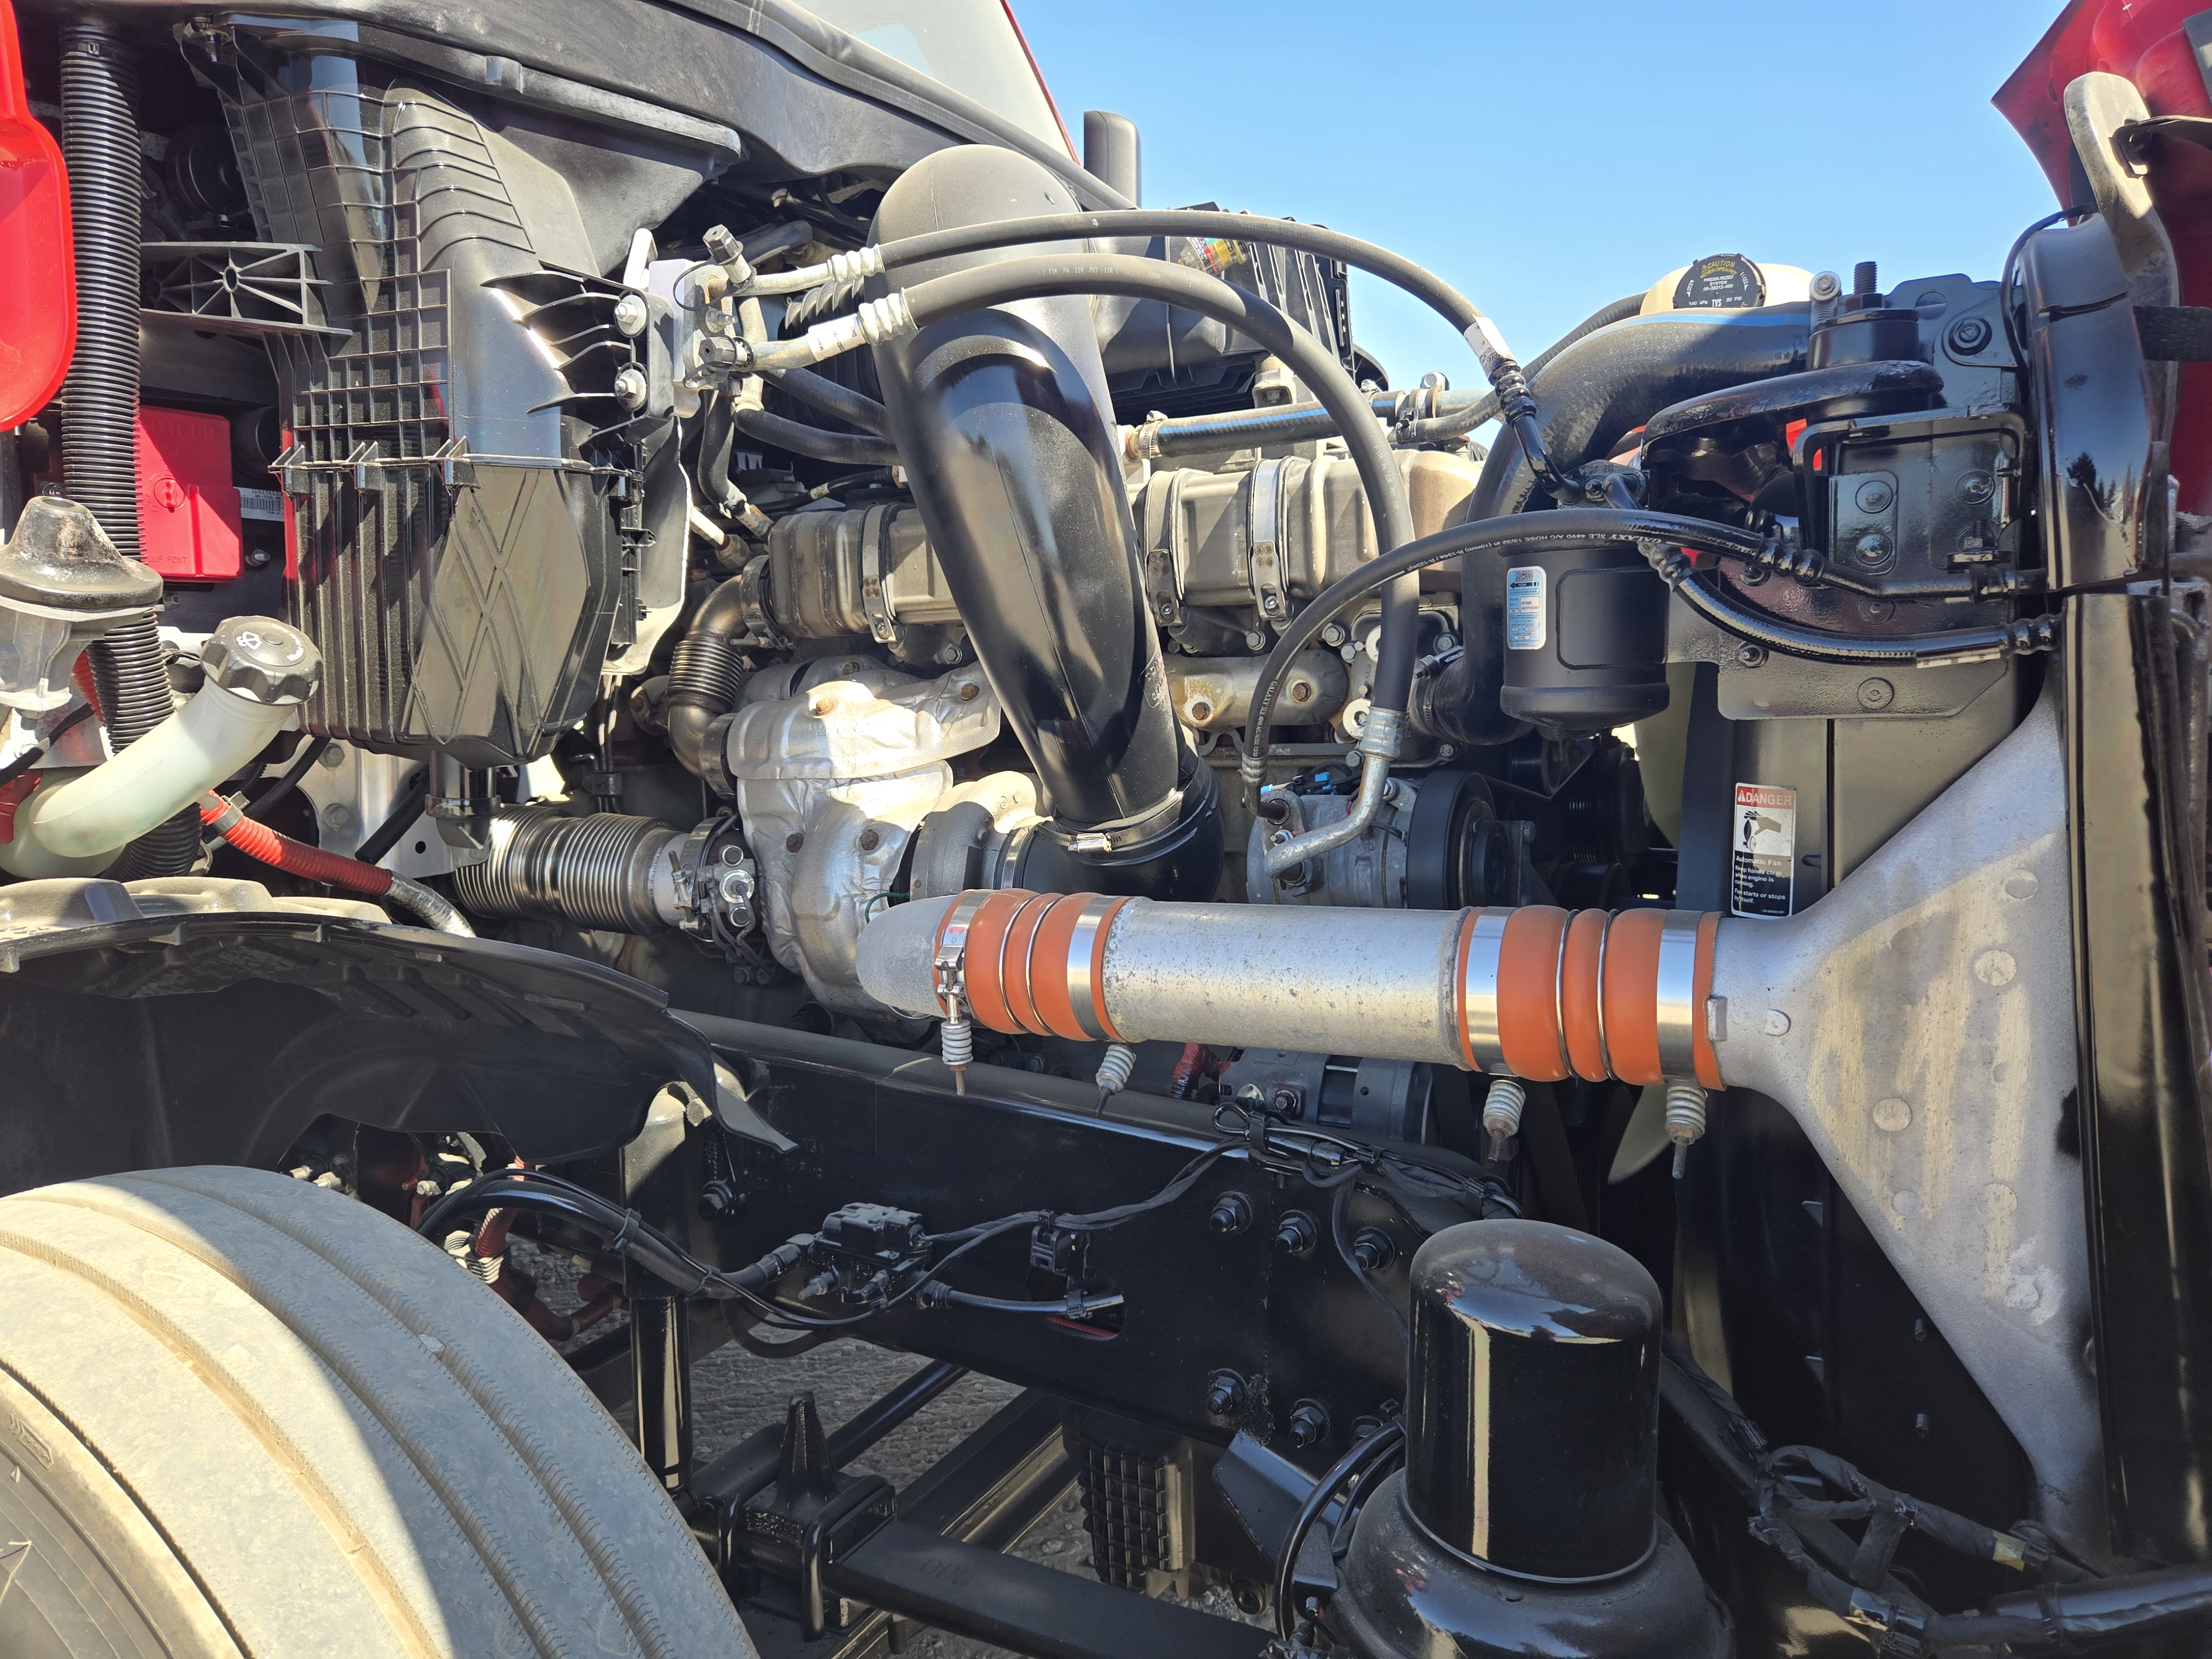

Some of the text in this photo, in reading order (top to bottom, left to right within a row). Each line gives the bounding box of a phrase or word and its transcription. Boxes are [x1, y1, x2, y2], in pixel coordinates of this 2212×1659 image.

[1700, 268, 1715, 279] NEVER
[1712, 299, 1721, 307] TVS
[1609, 534, 1662, 543] GALAXY
[1262, 681, 1277, 706] GALAXY
[1259, 706, 1267, 716] SLE
[1746, 791, 1792, 806] DANGER
[1736, 855, 1766, 864] Automatic
